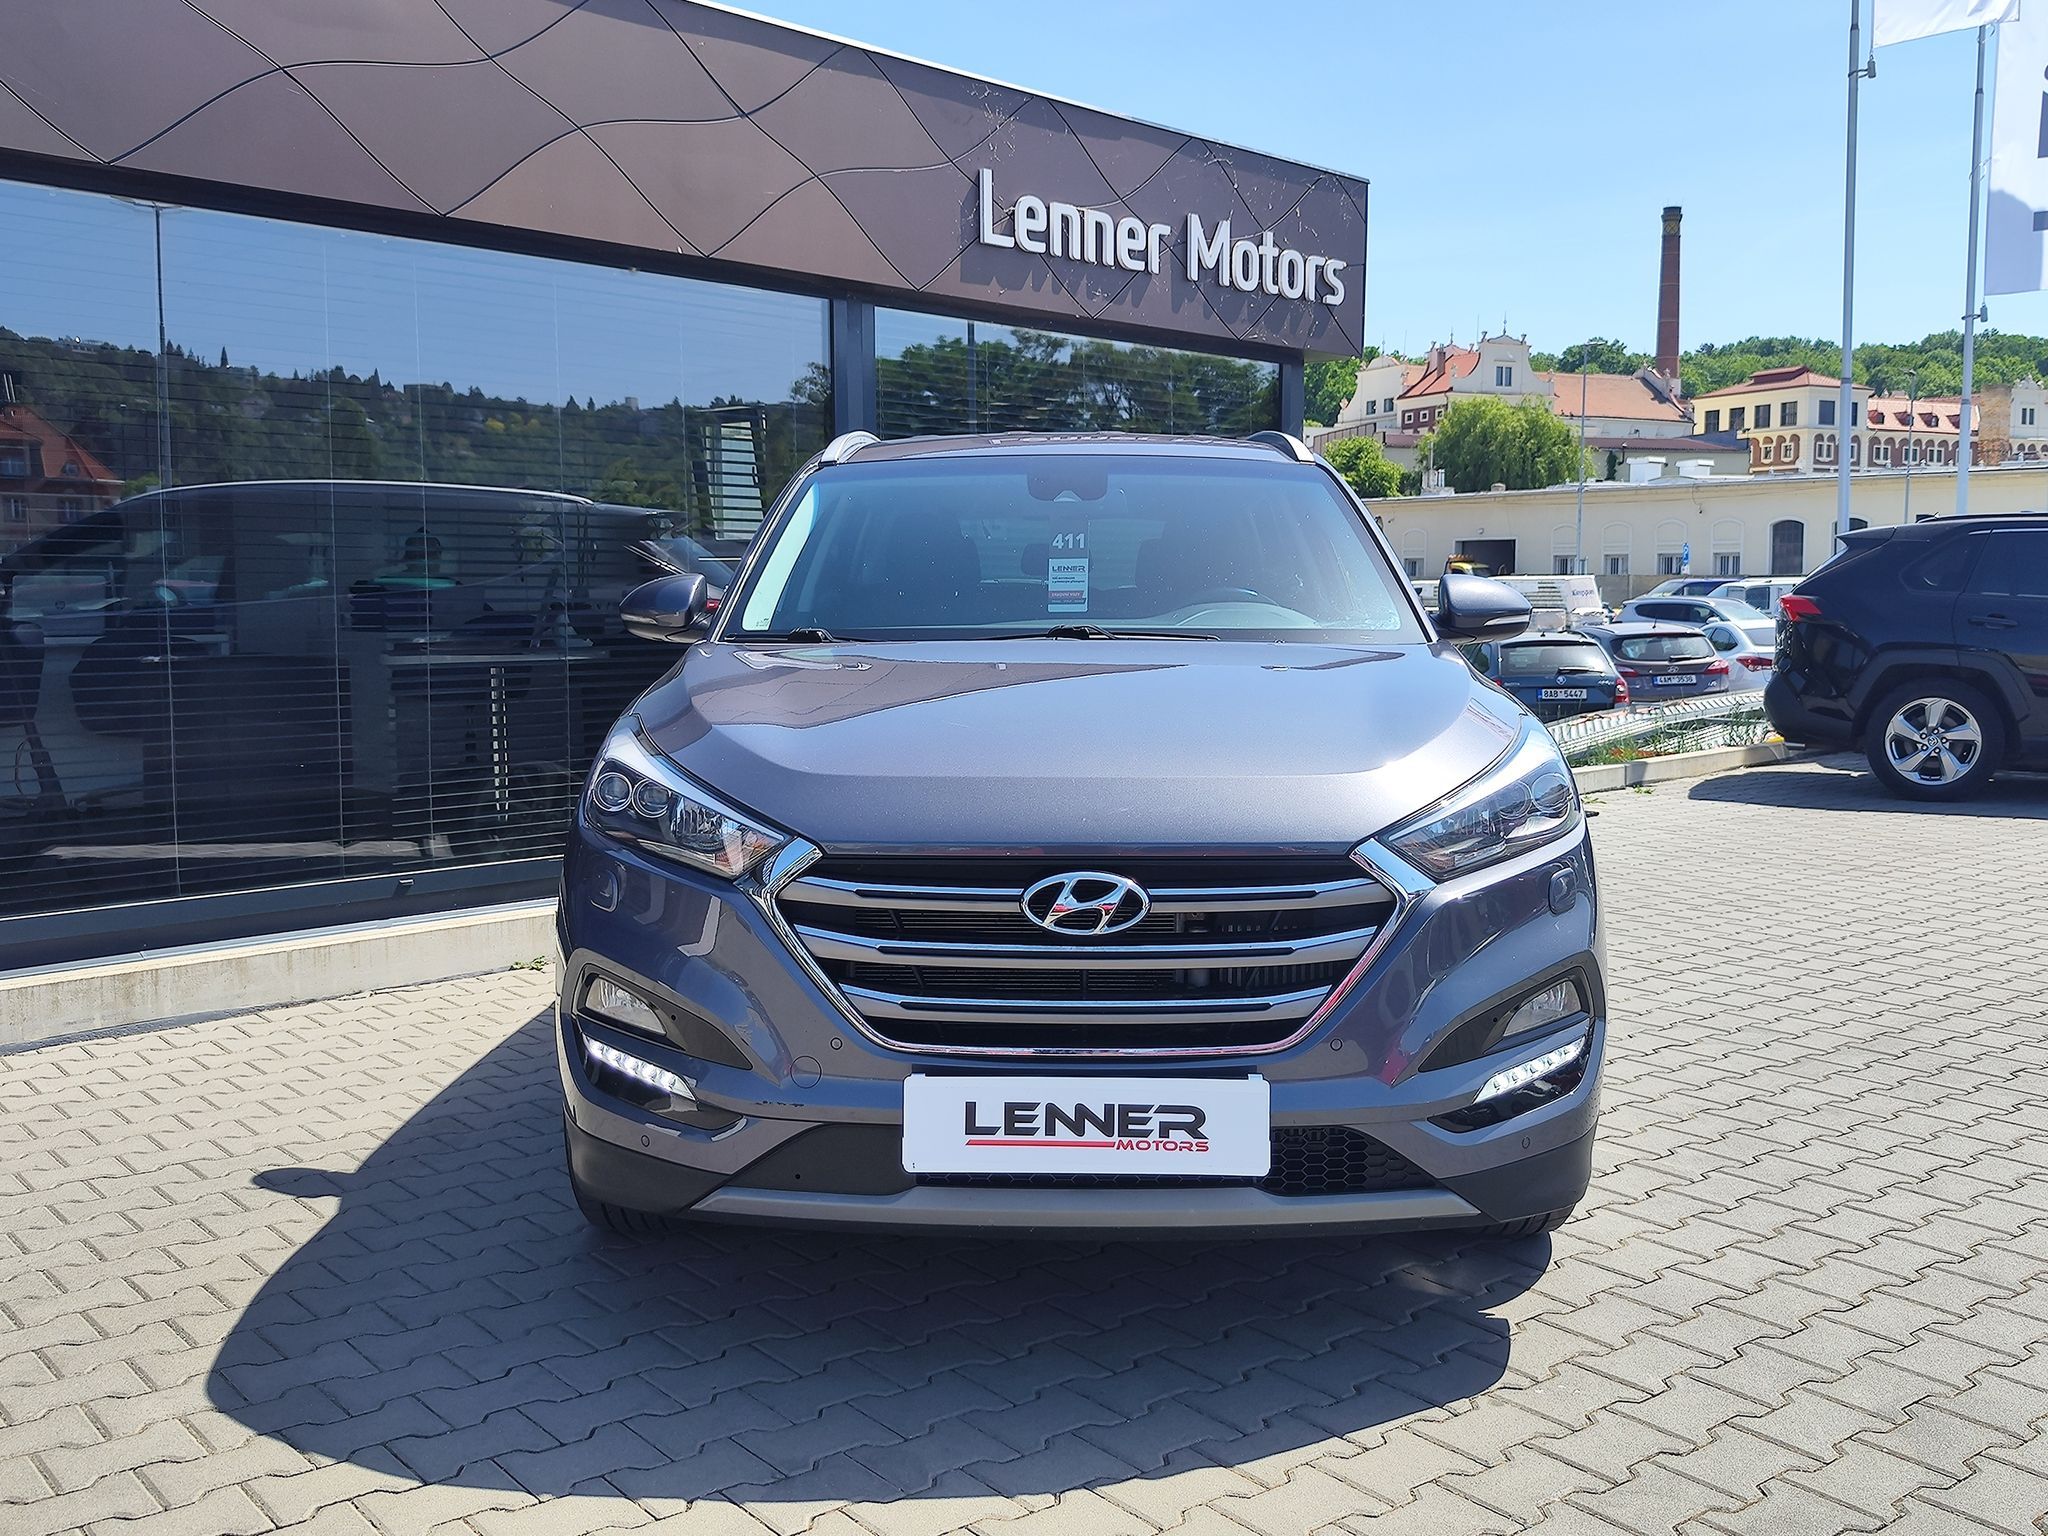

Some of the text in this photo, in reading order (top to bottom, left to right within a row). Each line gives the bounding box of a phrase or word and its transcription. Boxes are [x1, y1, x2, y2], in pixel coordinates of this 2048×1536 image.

[978, 168, 1346, 306] Lenner Motors
[1052, 532, 1085, 549] 411
[965, 1101, 1209, 1139] LENNER
[1115, 1138, 1210, 1152] MOTORS
